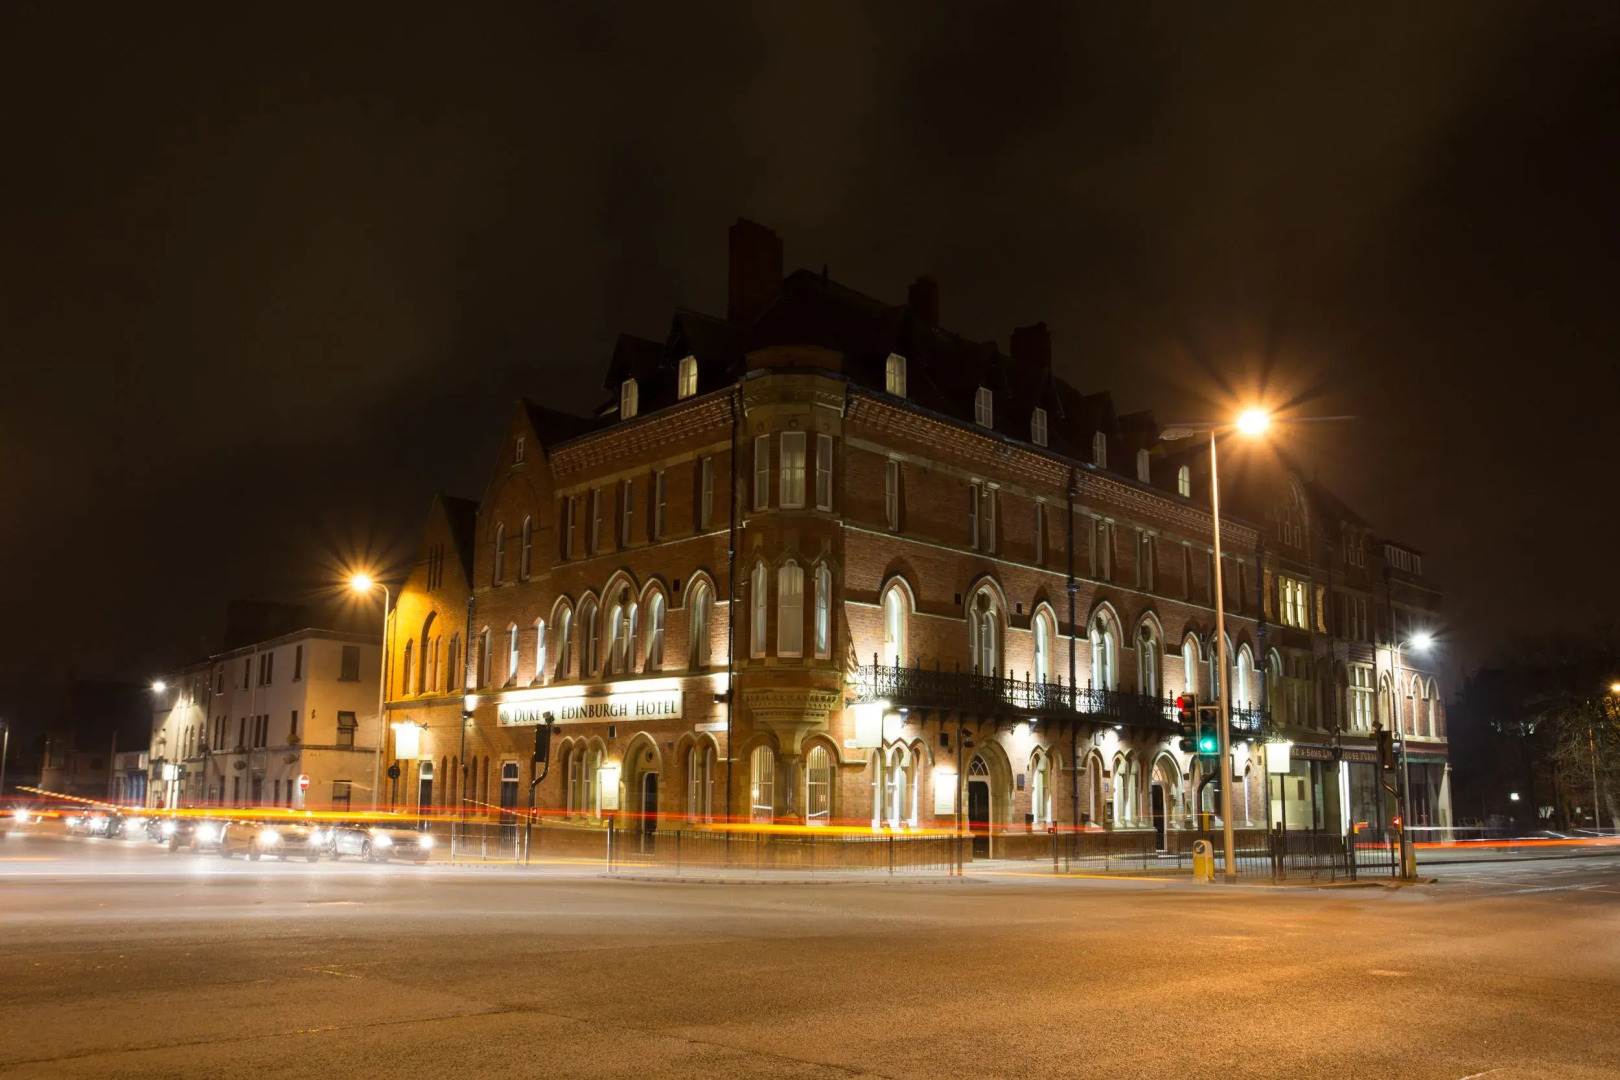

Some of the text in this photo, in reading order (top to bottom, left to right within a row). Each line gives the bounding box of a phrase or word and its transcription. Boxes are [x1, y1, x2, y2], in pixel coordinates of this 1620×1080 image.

[514, 707, 540, 722] DUKE
[561, 702, 628, 720] EDINBURGH
[636, 699, 677, 716] HOTEL
